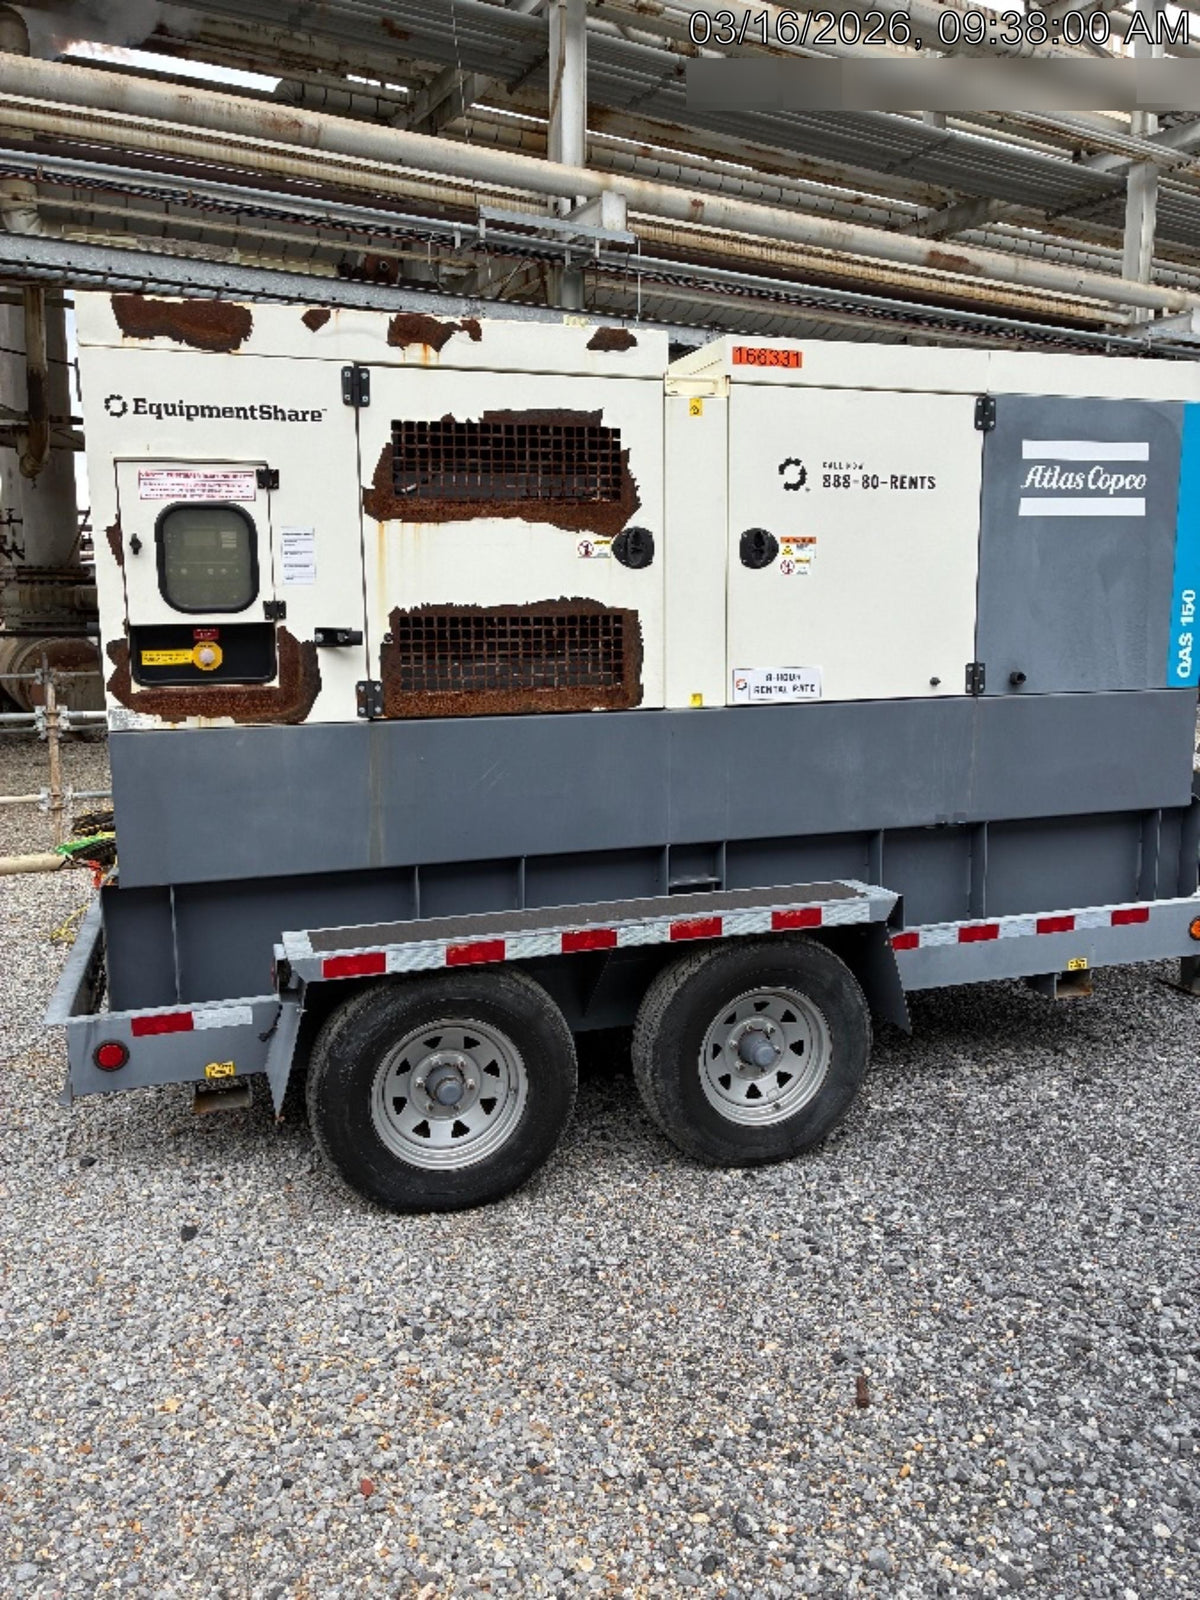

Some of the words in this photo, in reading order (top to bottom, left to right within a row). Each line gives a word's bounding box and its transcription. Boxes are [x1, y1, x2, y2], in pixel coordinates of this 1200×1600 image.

[132, 398, 323, 422] EquipmentShare
[822, 474, 936, 490] 888-80-RENTS
[1020, 465, 1085, 490] Atlas
[1087, 465, 1148, 495] Copco
[1180, 589, 1197, 627] 150
